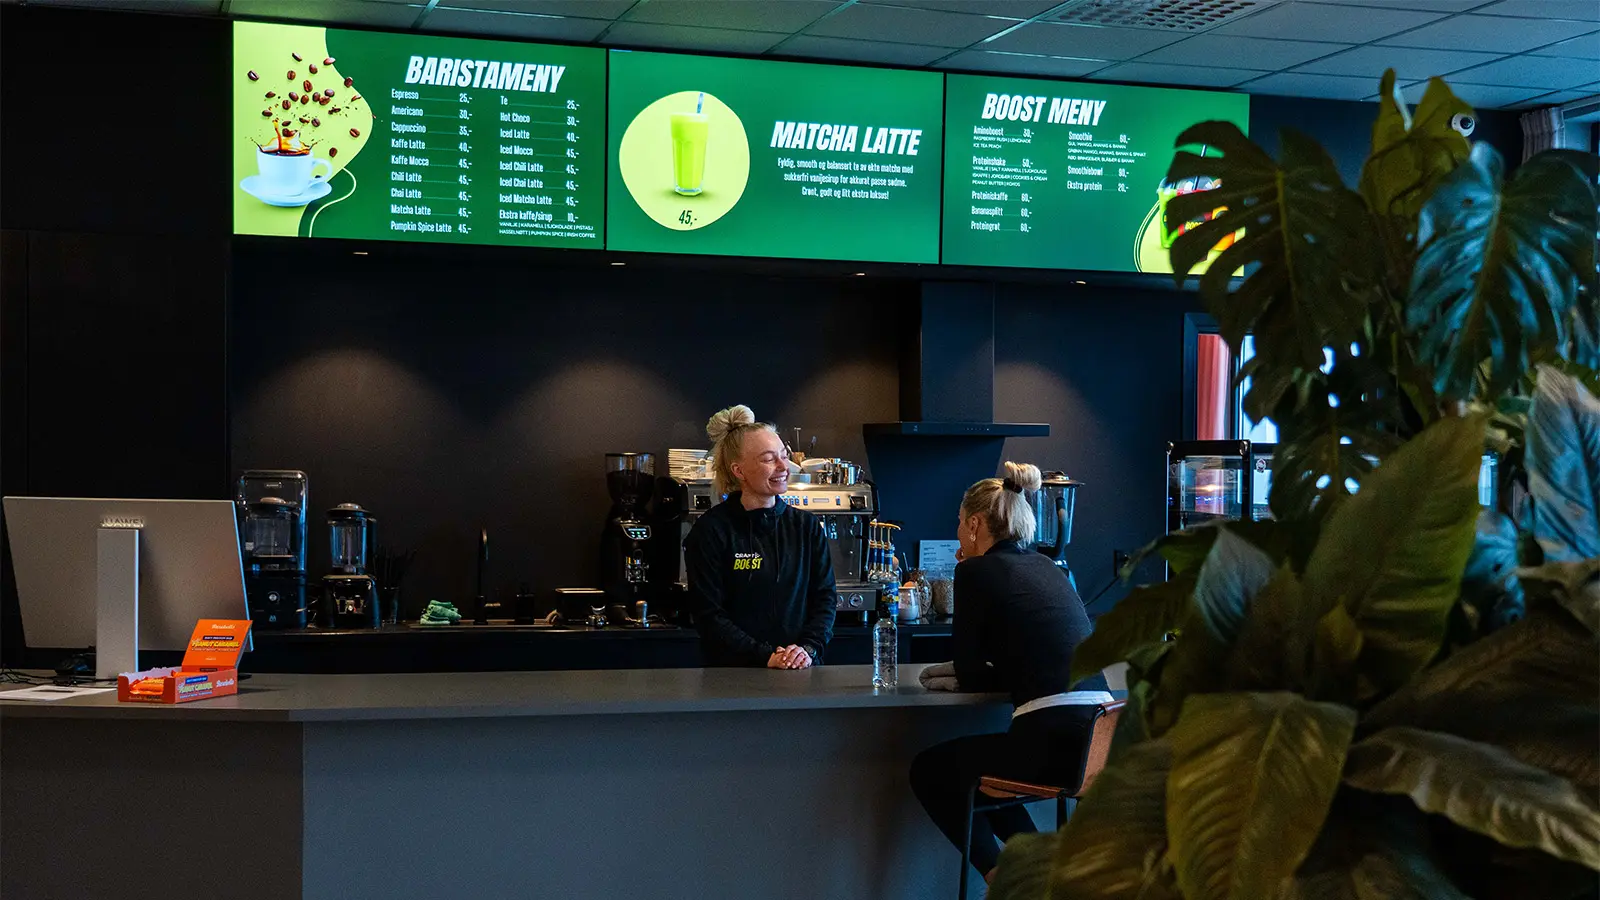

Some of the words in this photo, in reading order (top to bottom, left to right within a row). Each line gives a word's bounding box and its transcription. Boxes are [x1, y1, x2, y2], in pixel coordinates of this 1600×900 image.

[405, 55, 566, 93] BARISTAMENY
[391, 88, 419, 100] Espresso
[459, 93, 473, 104] 25,-
[500, 95, 508, 106] Te
[566, 99, 580, 110] 25,-
[391, 105, 424, 117] Americano
[459, 109, 473, 120] 30,-
[981, 93, 1047, 122] BOOST
[1047, 98, 1106, 126] MENY
[500, 112, 511, 122] Hot
[512, 112, 530, 123] Choco
[566, 116, 580, 127] 30,-
[391, 121, 427, 134] Cappuccino
[459, 125, 473, 137] 35,-
[500, 128, 513, 138] Iced
[514, 129, 530, 139] Latte
[566, 132, 580, 143] 40,-
[973, 125, 1004, 136] Aminoboost
[1023, 128, 1035, 138] 30,-
[1068, 131, 1092, 141] Smoothie
[391, 138, 408, 149] Kaffe
[409, 139, 426, 150] Latte
[458, 142, 473, 153] 40,-
[770, 121, 858, 152] MATCHA
[861, 127, 922, 155] LATTE
[500, 144, 513, 155] Iced
[513, 145, 534, 156] Mocca
[566, 148, 580, 159] 45,-
[391, 154, 408, 165] Kaffe
[408, 155, 429, 166] Mocca
[458, 158, 472, 169] 45,-
[499, 161, 513, 171] Iced
[513, 161, 527, 172] Chili
[527, 162, 544, 173] Latte
[565, 164, 580, 175] 45,-
[777, 157, 796, 169] Fyldig,
[797, 160, 818, 169] smooth
[818, 161, 826, 170] og
[826, 160, 852, 171] balansert
[853, 162, 860, 171] te
[860, 163, 867, 171] av
[867, 162, 880, 172] ekte
[880, 163, 901, 173] matcha
[901, 164, 914, 174] med
[972, 156, 1006, 166] Proteinshake
[1022, 158, 1033, 168] 50,-
[1067, 165, 1103, 176] Smoothiebowl
[391, 171, 405, 181] Chili
[405, 172, 422, 183] Latte
[458, 175, 472, 186] 45,-
[499, 177, 513, 187] Iced
[513, 178, 527, 188] Chai
[527, 178, 544, 189] Latte
[565, 180, 580, 191] 45,-
[783, 172, 809, 182] sukkerfri
[840, 174, 849, 184] for
[849, 175, 870, 185] akkurat
[870, 178, 887, 187] passe
[887, 177, 907, 187] sødme.
[820, 188, 833, 198] godt
[833, 189, 841, 199] og
[841, 188, 851, 198] litt
[851, 189, 869, 199] ekstra
[869, 190, 889, 200] luksus!
[1067, 180, 1083, 190] Ekstra
[1084, 182, 1102, 191] protein
[1118, 183, 1129, 193] 20,-
[391, 187, 405, 198] Chai
[405, 188, 422, 199] Latte
[458, 191, 472, 202] 45,-
[499, 193, 512, 203] Iced
[513, 194, 536, 204] Matcha
[536, 195, 553, 205] Latte
[565, 196, 579, 207] 45,-
[971, 190, 1008, 201] Proteiniskaffe
[391, 204, 414, 215] Matcha
[414, 205, 432, 216] Latte
[458, 207, 472, 218] 45,-
[499, 209, 518, 220] Ekstra
[519, 210, 553, 223] kaffe/sirup
[567, 212, 579, 223] 10,-
[678, 209, 698, 227] 45,-
[390, 221, 417, 232] Pumpkin
[417, 221, 435, 234] Spice
[435, 222, 452, 233] Latte
[458, 223, 472, 234] 45,-
